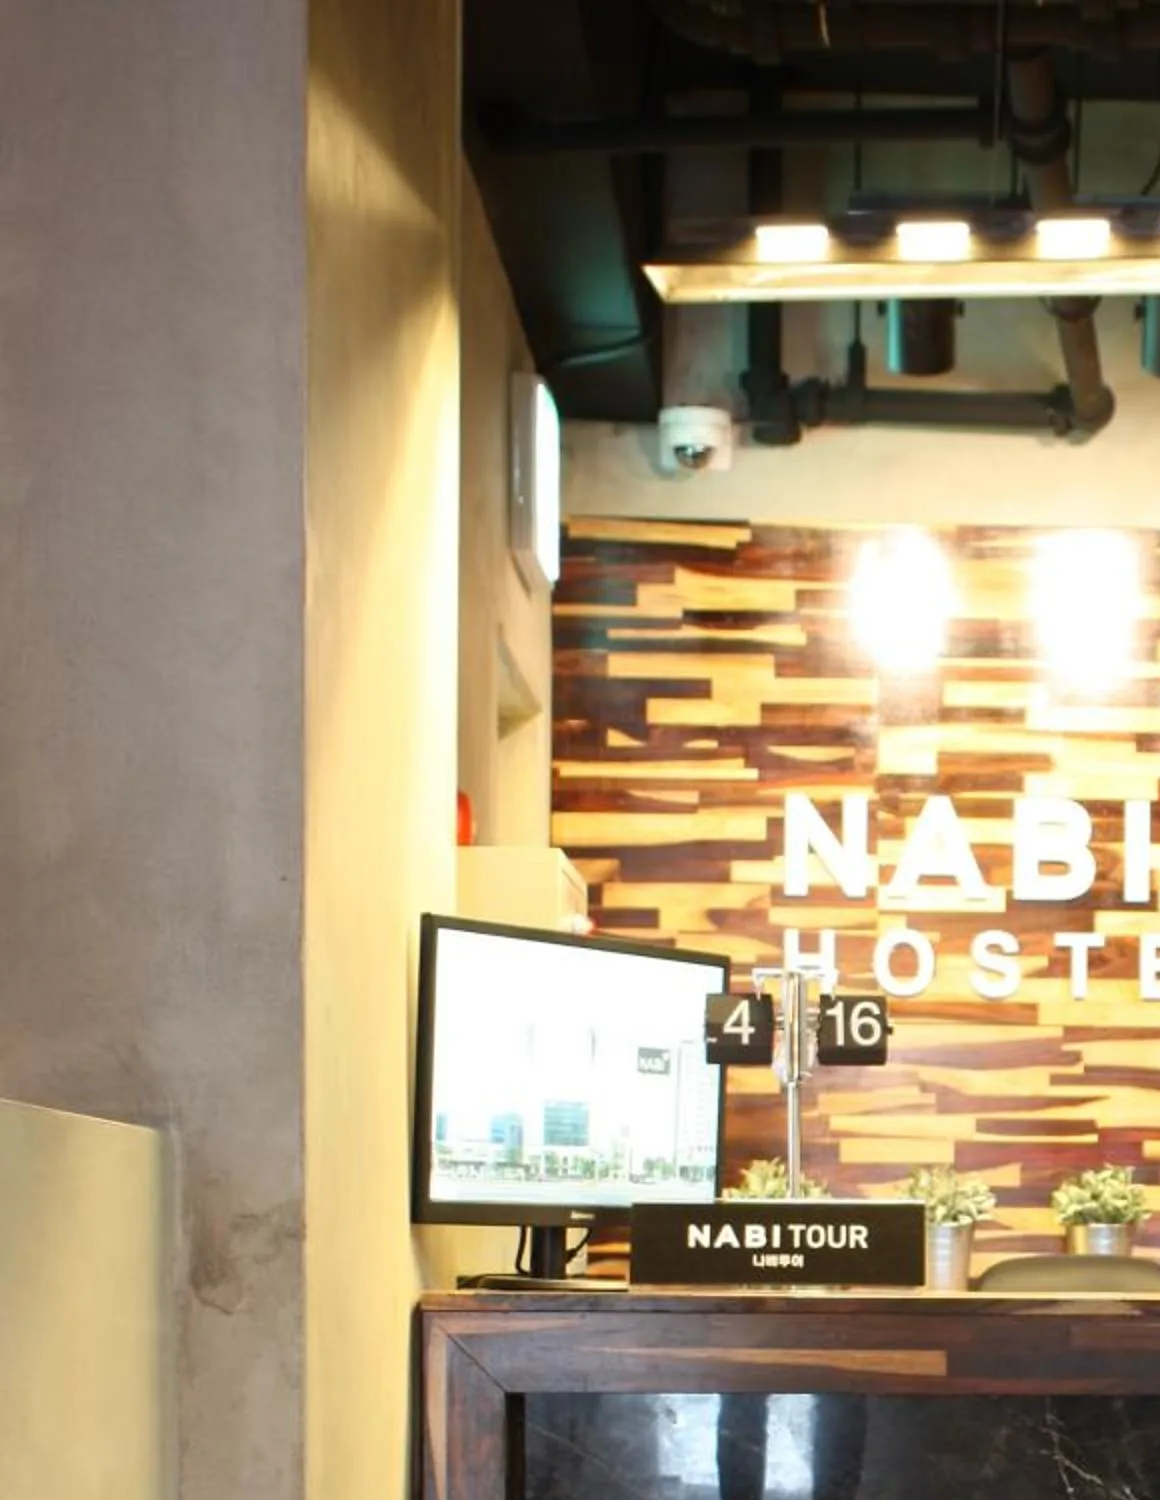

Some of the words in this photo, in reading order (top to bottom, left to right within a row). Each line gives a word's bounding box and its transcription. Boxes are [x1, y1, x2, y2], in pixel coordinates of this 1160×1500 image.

[783, 794, 1151, 902] NABI
[723, 1000, 755, 1045] 4
[826, 1001, 881, 1047] 16
